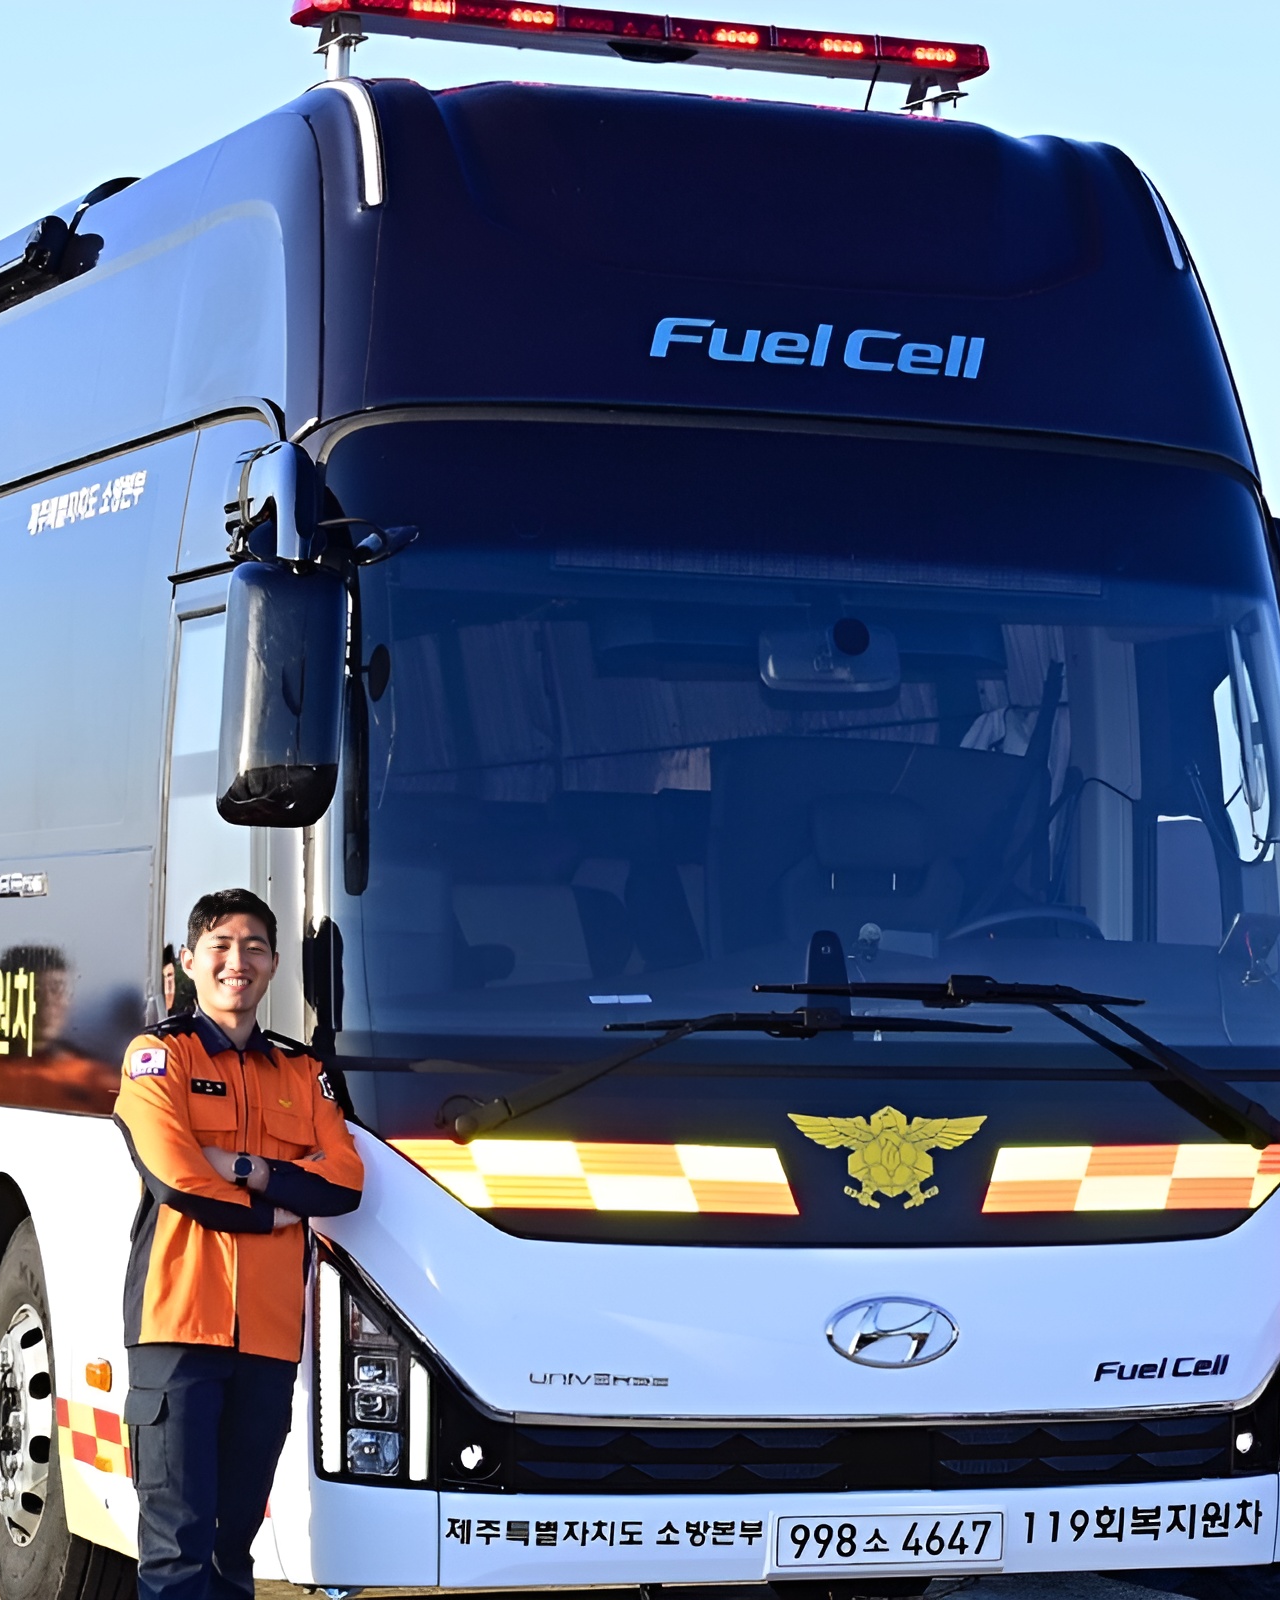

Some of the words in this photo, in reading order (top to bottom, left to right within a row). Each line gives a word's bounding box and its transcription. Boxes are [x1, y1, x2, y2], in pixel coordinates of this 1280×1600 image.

[649, 317, 833, 367] Fuel
[843, 328, 986, 379] Cell
[1093, 1357, 1168, 1383] Fuel
[1171, 1354, 1230, 1378] Cell
[445, 1517, 643, 1547] 제주특별자치도
[655, 1520, 763, 1547] 소방본부
[901, 1520, 992, 1557] 4647
